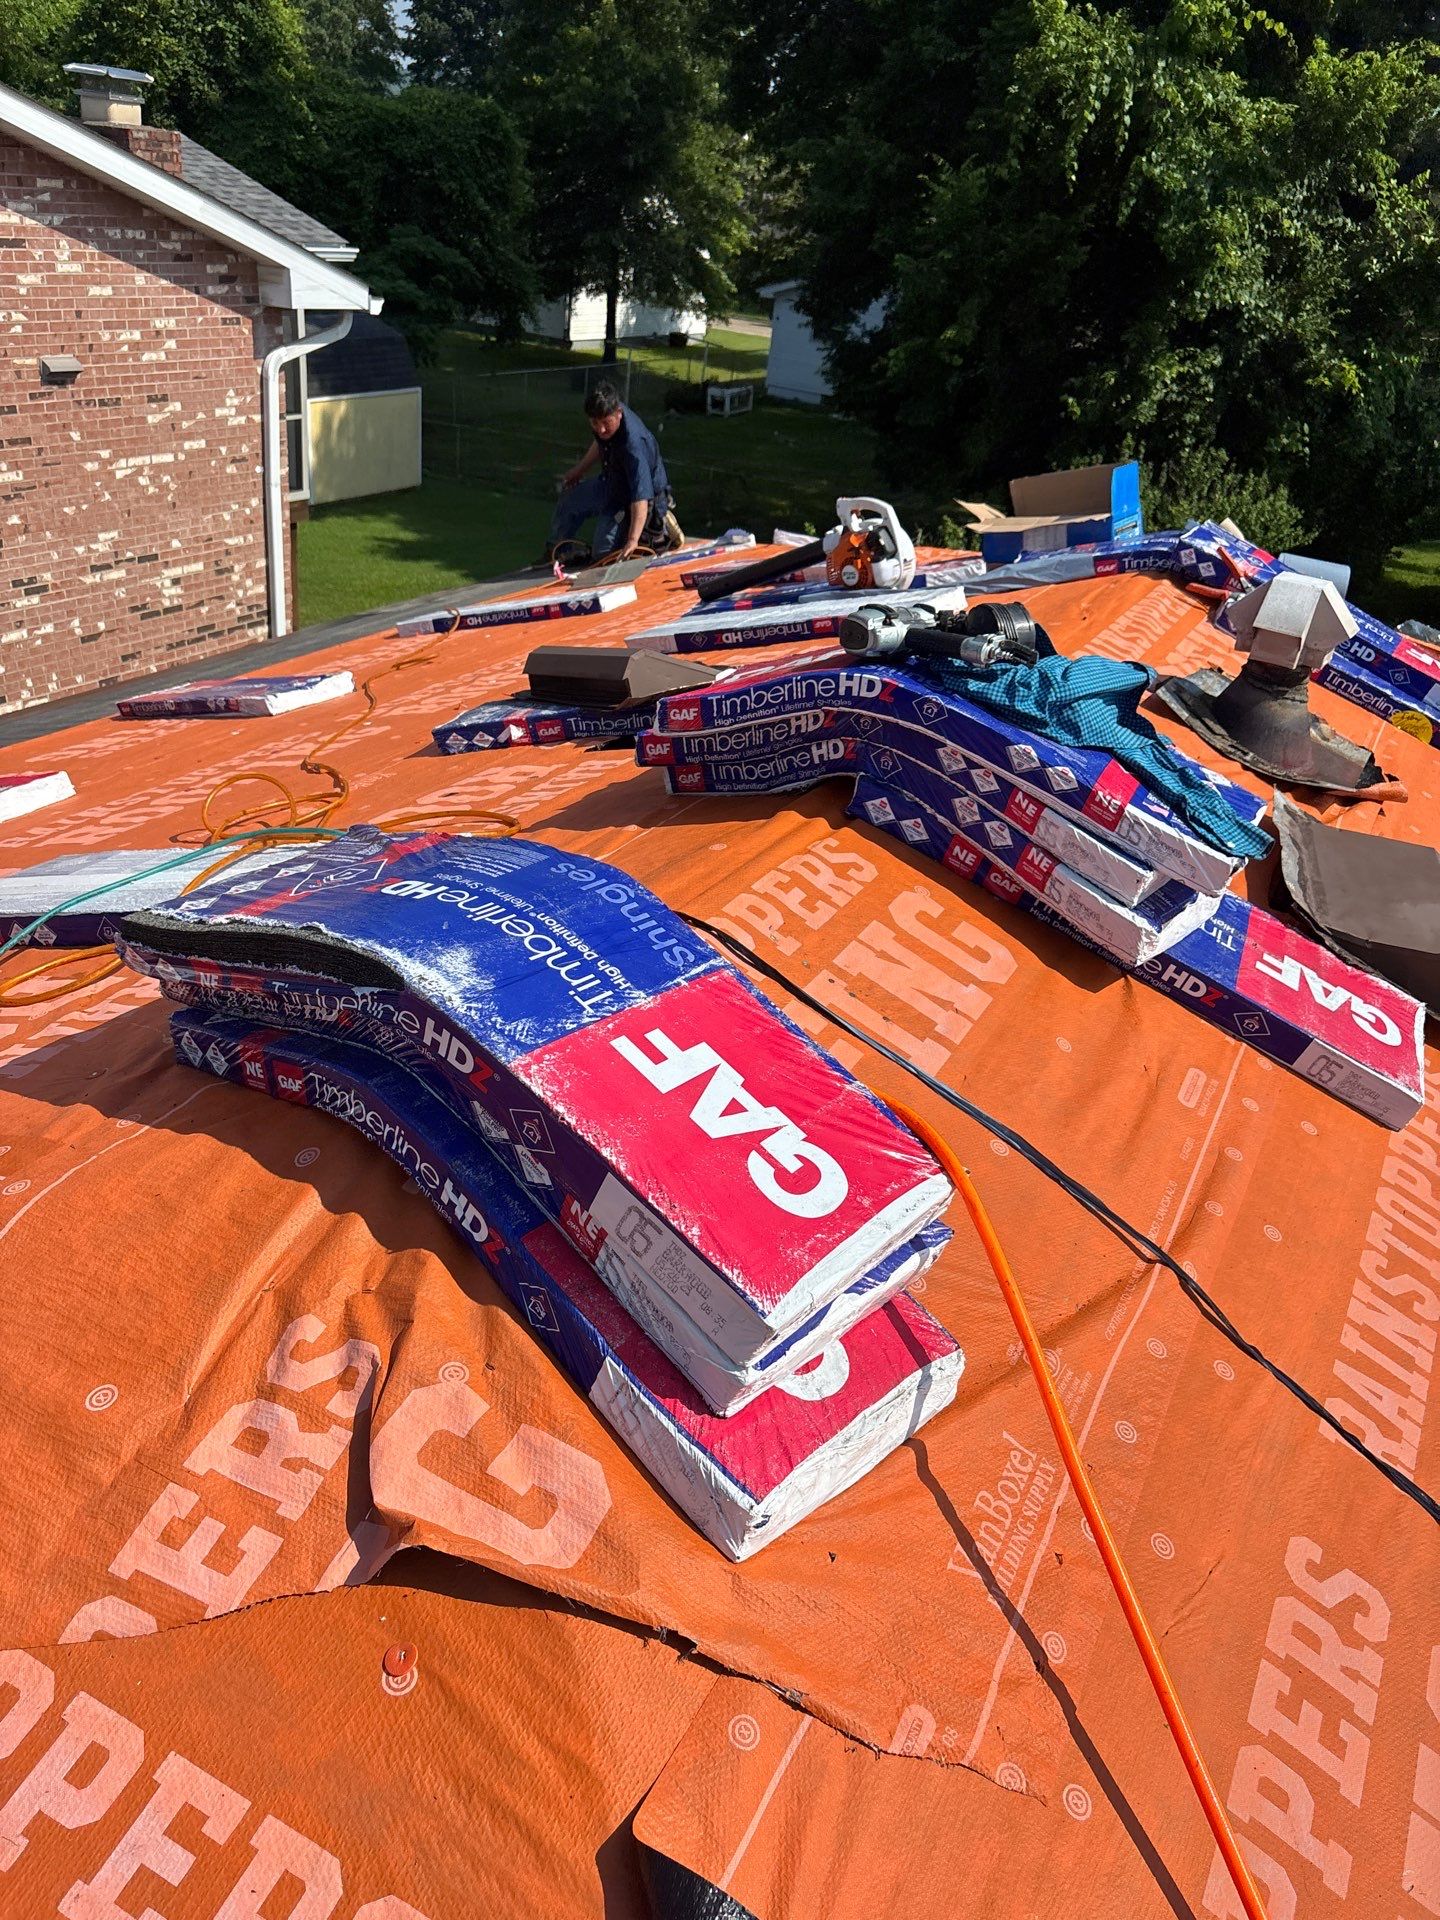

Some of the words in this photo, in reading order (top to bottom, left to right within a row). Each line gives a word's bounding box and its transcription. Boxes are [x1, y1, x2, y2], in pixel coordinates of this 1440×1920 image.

[714, 630, 743, 645] HDZ
[742, 620, 811, 640] Timberline
[670, 707, 699, 721] GAF
[708, 676, 836, 717] Timberline
[838, 673, 897, 704] HDZ
[539, 725, 562, 738] GAF
[646, 742, 670, 756] GAF
[682, 722, 788, 754] Timberline
[789, 709, 837, 736] HDZ
[678, 772, 701, 785] GAF
[709, 751, 810, 781] Timberline
[811, 738, 857, 765] HDZ
[1015, 790, 1037, 817] NE
[952, 845, 977, 866] NE
[1027, 847, 1053, 873] NE
[360, 877, 450, 899] HDZ
[989, 869, 1024, 896] GAF
[536, 912, 599, 960] Definition
[1028, 906, 1054, 925] High
[437, 890, 614, 1014] Timberline
[597, 960, 631, 990] High
[1161, 964, 1218, 1008] HDZ
[1255, 951, 1402, 1047] GAF
[244, 1060, 265, 1080] NE
[422, 1016, 494, 1095] HDZ
[1305, 1053, 1344, 1086] 05
[609, 1028, 849, 1219] GAF
[277, 1074, 303, 1093] GAF
[307, 1072, 440, 1190] Timberline
[440, 1178, 505, 1265] HDZ
[570, 1199, 601, 1241] NE
[612, 1204, 664, 1259] 05
[370, 1384, 613, 1569] G
[1022, 1456, 1057, 1525] SUPPLY
[947, 1430, 1036, 1580] VanBoxel
